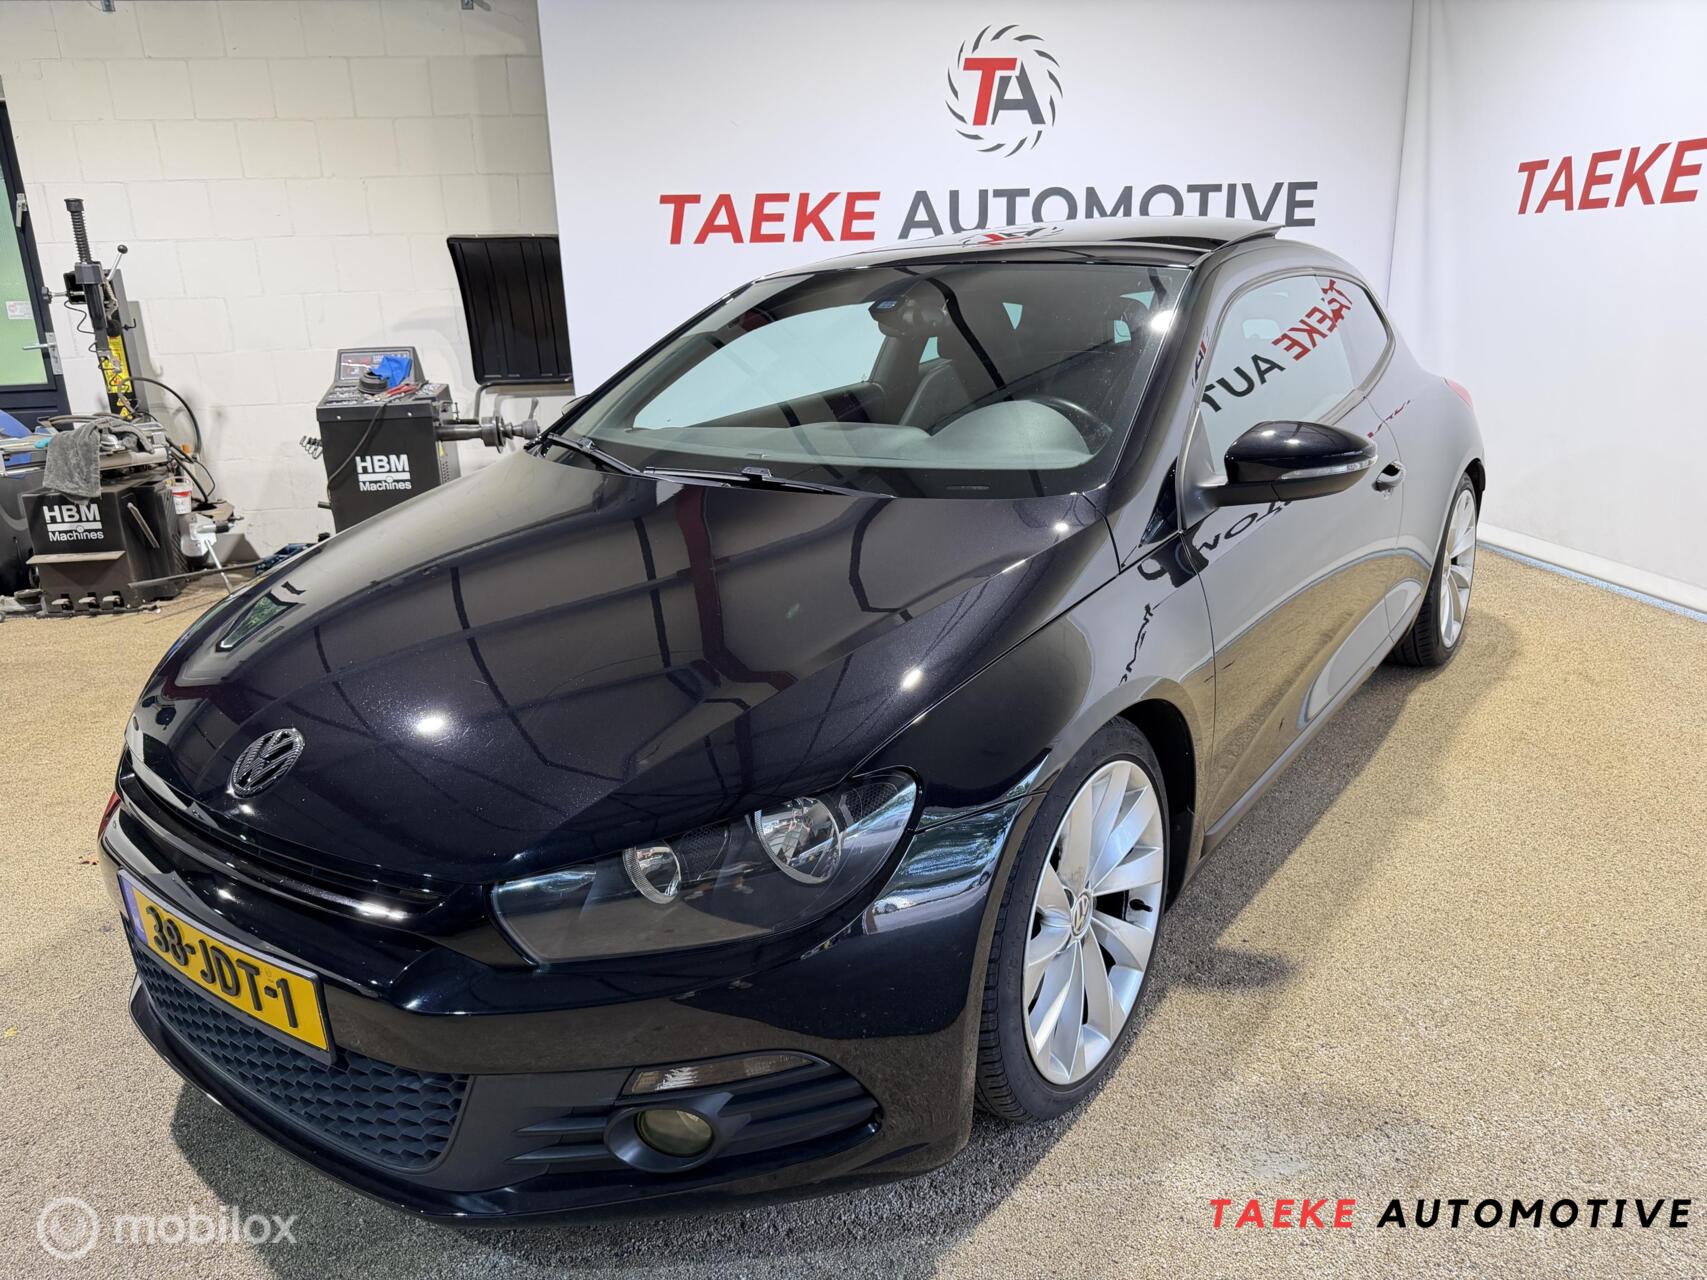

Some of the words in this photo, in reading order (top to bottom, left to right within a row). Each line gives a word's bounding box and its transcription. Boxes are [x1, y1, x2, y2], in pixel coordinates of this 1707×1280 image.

[963, 57, 1045, 126] TA
[1518, 138, 1707, 214] TAEKE
[660, 192, 880, 245] TAEKE
[898, 181, 1318, 239] AUTOMOTIVE
[355, 454, 410, 473] HBM
[359, 481, 412, 491] Machines
[43, 504, 101, 523] HBM
[49, 531, 104, 541] Machines
[146, 905, 298, 1029] 38-JDT-1
